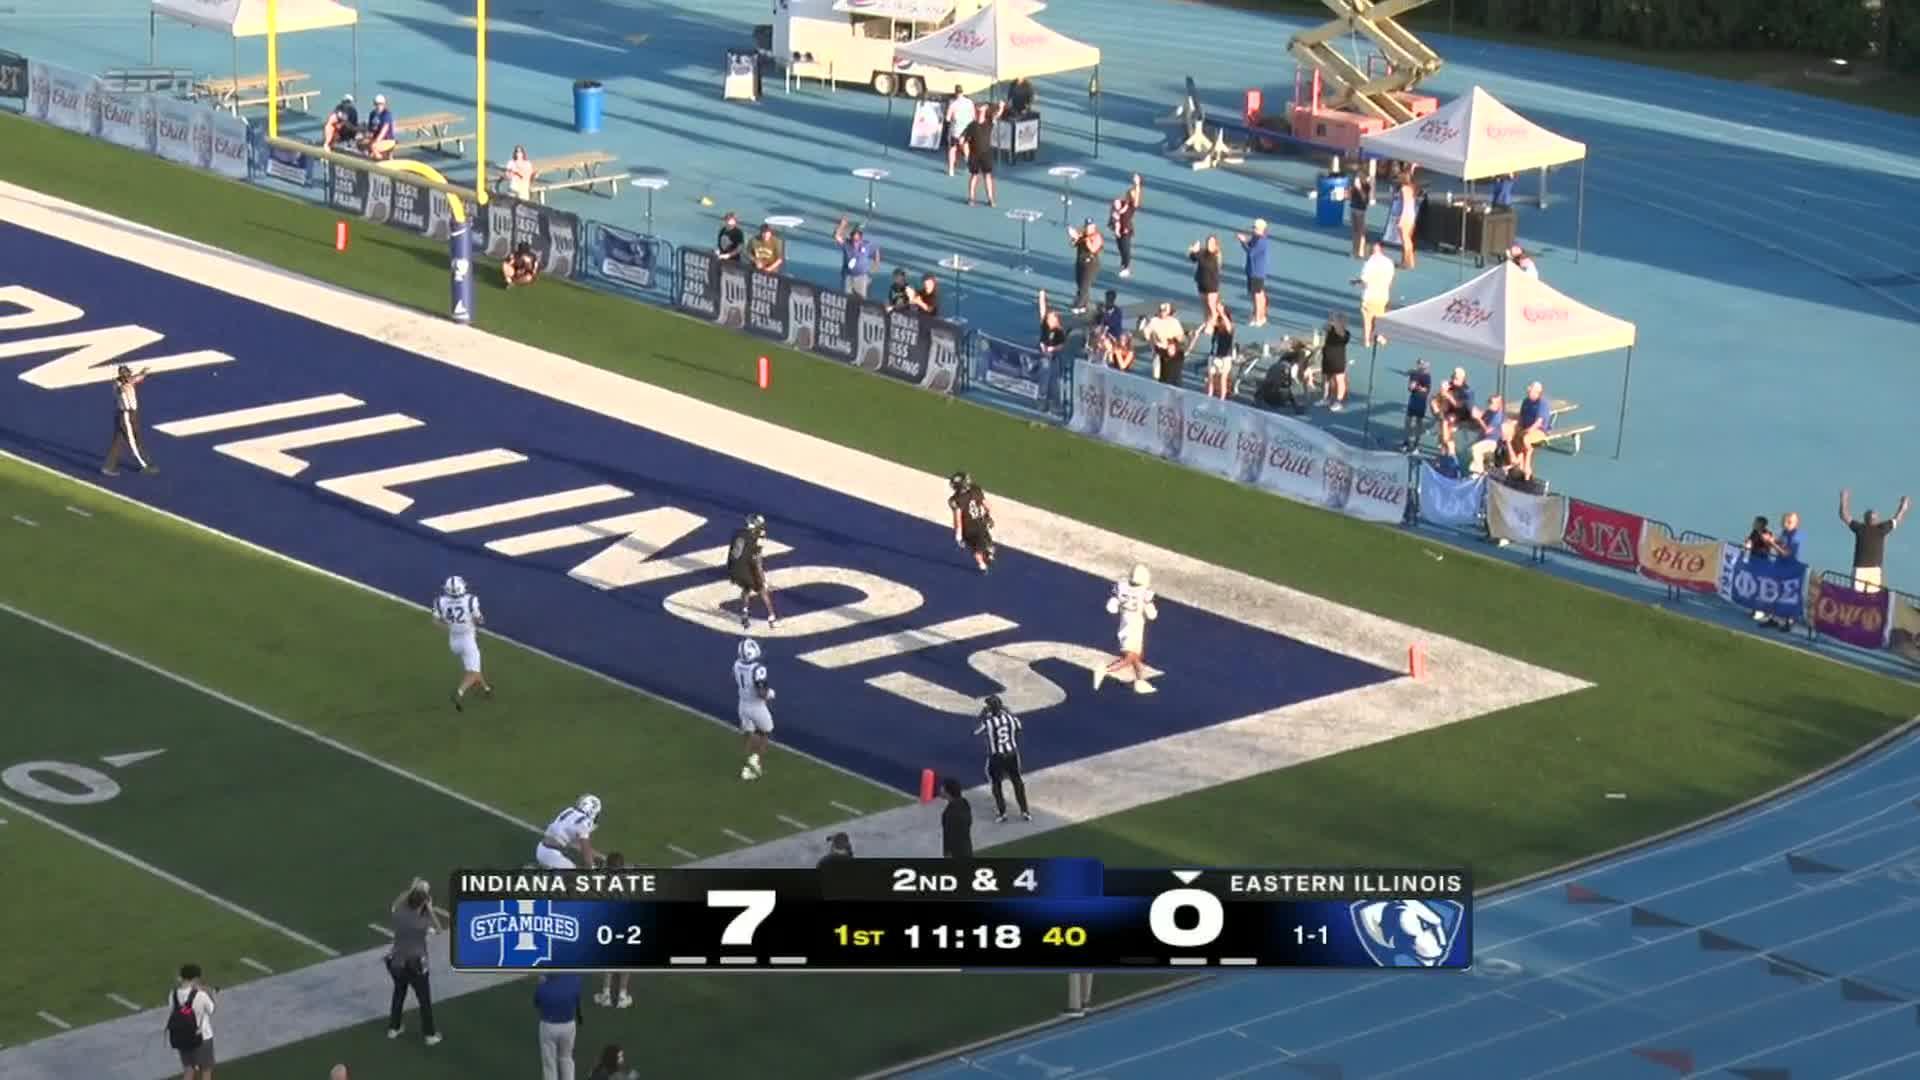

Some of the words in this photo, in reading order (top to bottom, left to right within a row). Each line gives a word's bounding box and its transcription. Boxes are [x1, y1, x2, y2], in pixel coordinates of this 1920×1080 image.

[1109, 396, 1150, 427] Chill
[1187, 421, 1230, 450] Chill
[1270, 447, 1313, 478] Chill
[1356, 473, 1404, 504] Chill
[151, 391, 1167, 716] ILLINOIS
[446, 606, 466, 624] 42
[997, 727, 1010, 744] S
